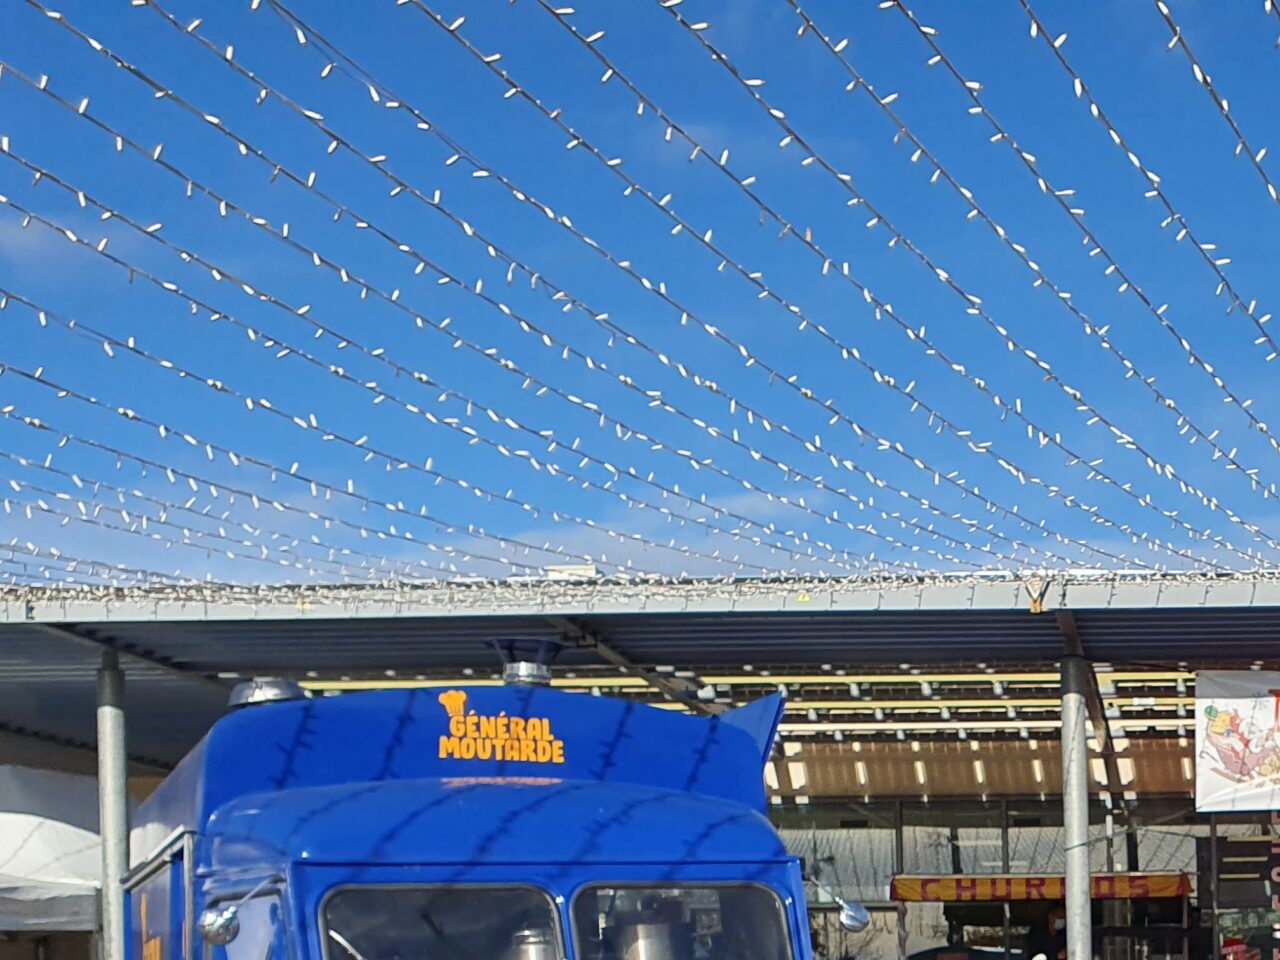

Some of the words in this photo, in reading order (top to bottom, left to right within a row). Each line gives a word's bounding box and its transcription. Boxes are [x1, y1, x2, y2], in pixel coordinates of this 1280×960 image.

[449, 709, 555, 741] GÉNÉRAL
[438, 735, 565, 764] MOUTARDE
[920, 878, 1150, 901] CHUROS
